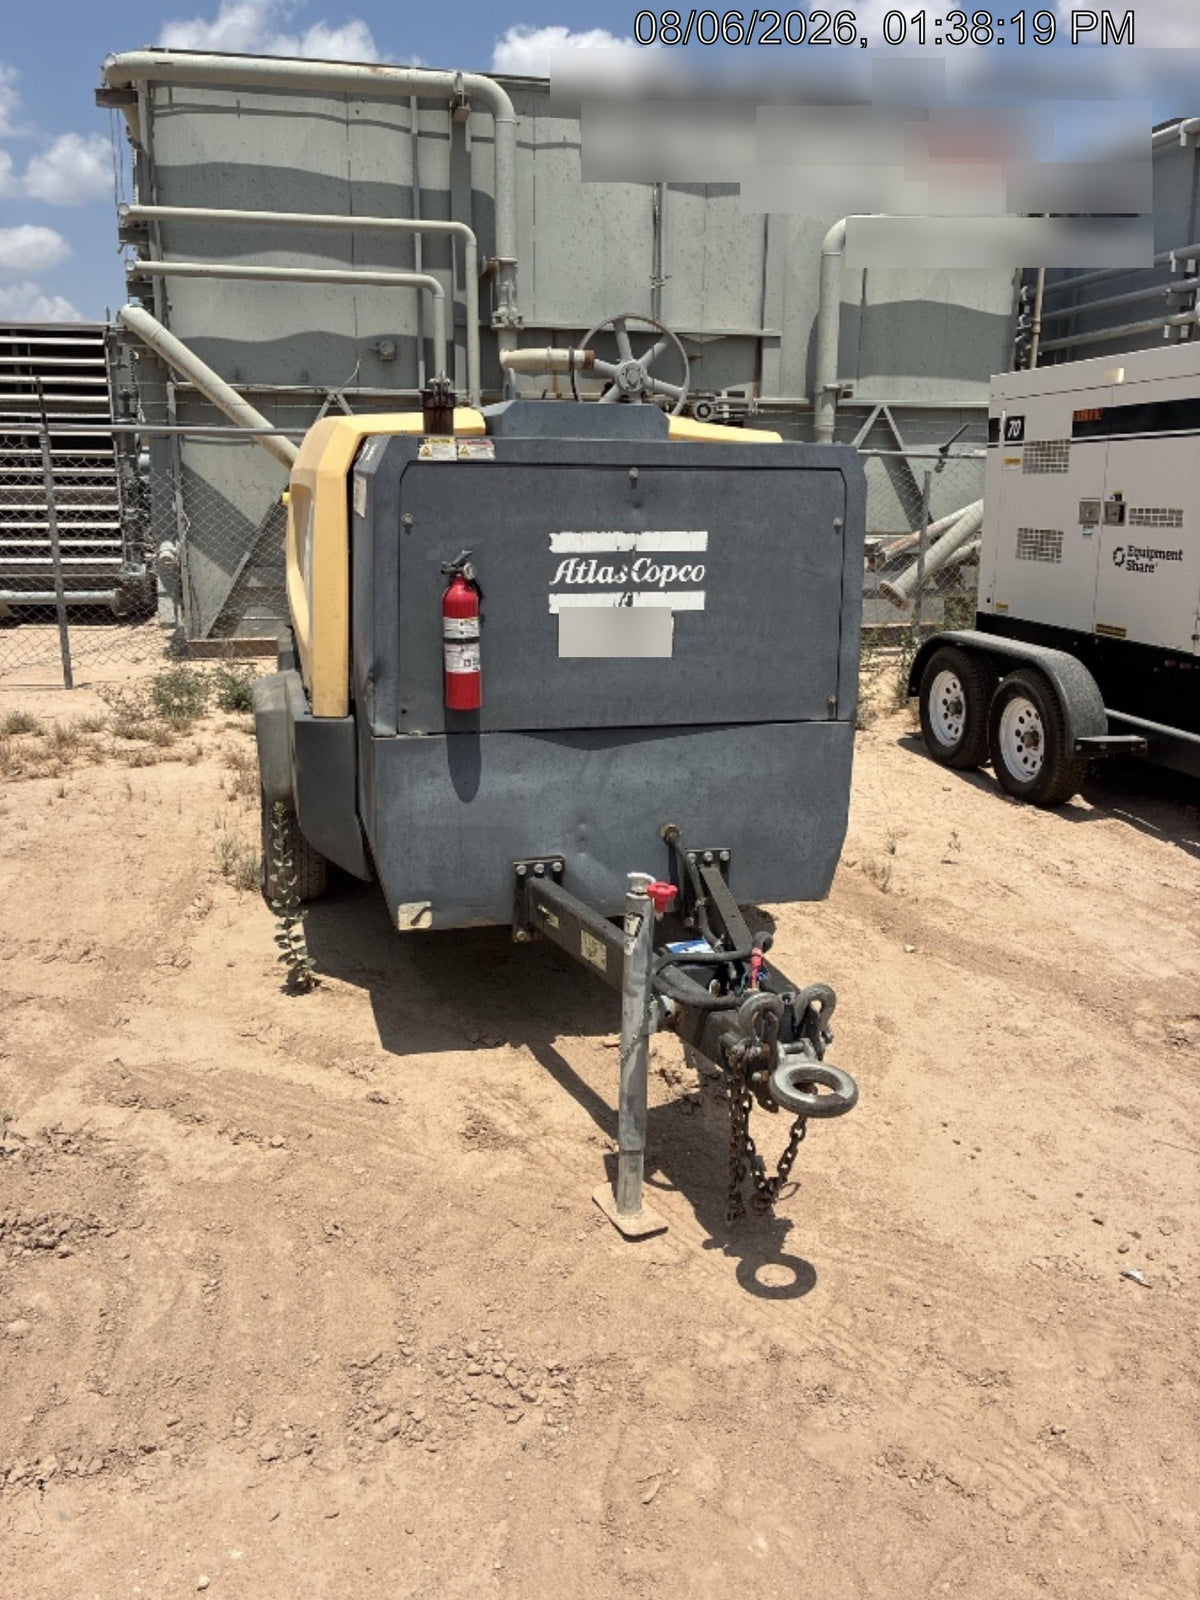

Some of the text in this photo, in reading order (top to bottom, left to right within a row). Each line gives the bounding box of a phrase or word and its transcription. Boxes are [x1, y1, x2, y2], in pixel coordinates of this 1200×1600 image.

[1007, 419, 1022, 438] 70
[1127, 545, 1183, 561] Equipment
[549, 557, 706, 588] Atlas Copco
[1126, 559, 1155, 573] Share
